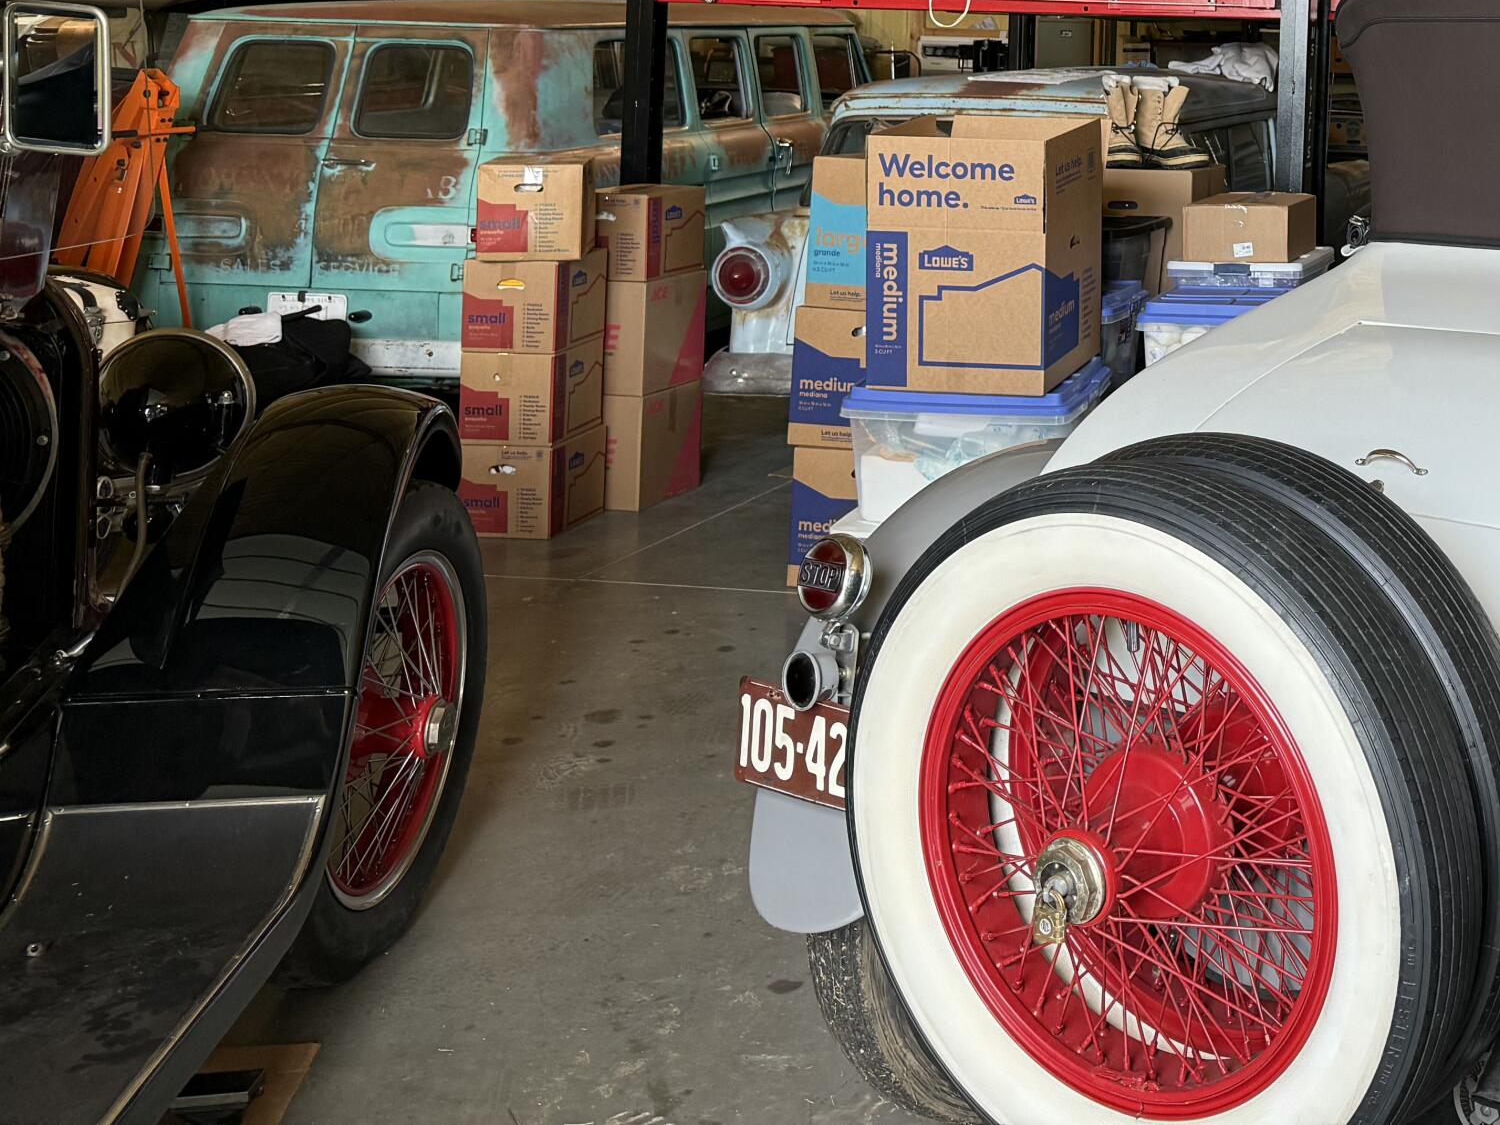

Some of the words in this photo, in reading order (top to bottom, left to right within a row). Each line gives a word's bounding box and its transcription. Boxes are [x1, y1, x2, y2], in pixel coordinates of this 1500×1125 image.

[878, 153, 1015, 181] Welcome
[878, 181, 969, 209] home.
[480, 218, 520, 229] small
[814, 248, 841, 257] grande
[875, 243, 883, 278] mediana
[924, 254, 968, 269] LOWE'S
[882, 242, 904, 342] medium
[468, 312, 506, 324] small
[799, 390, 828, 399] mediana
[464, 404, 502, 416] small
[464, 496, 500, 508] small
[801, 562, 839, 586] STOP
